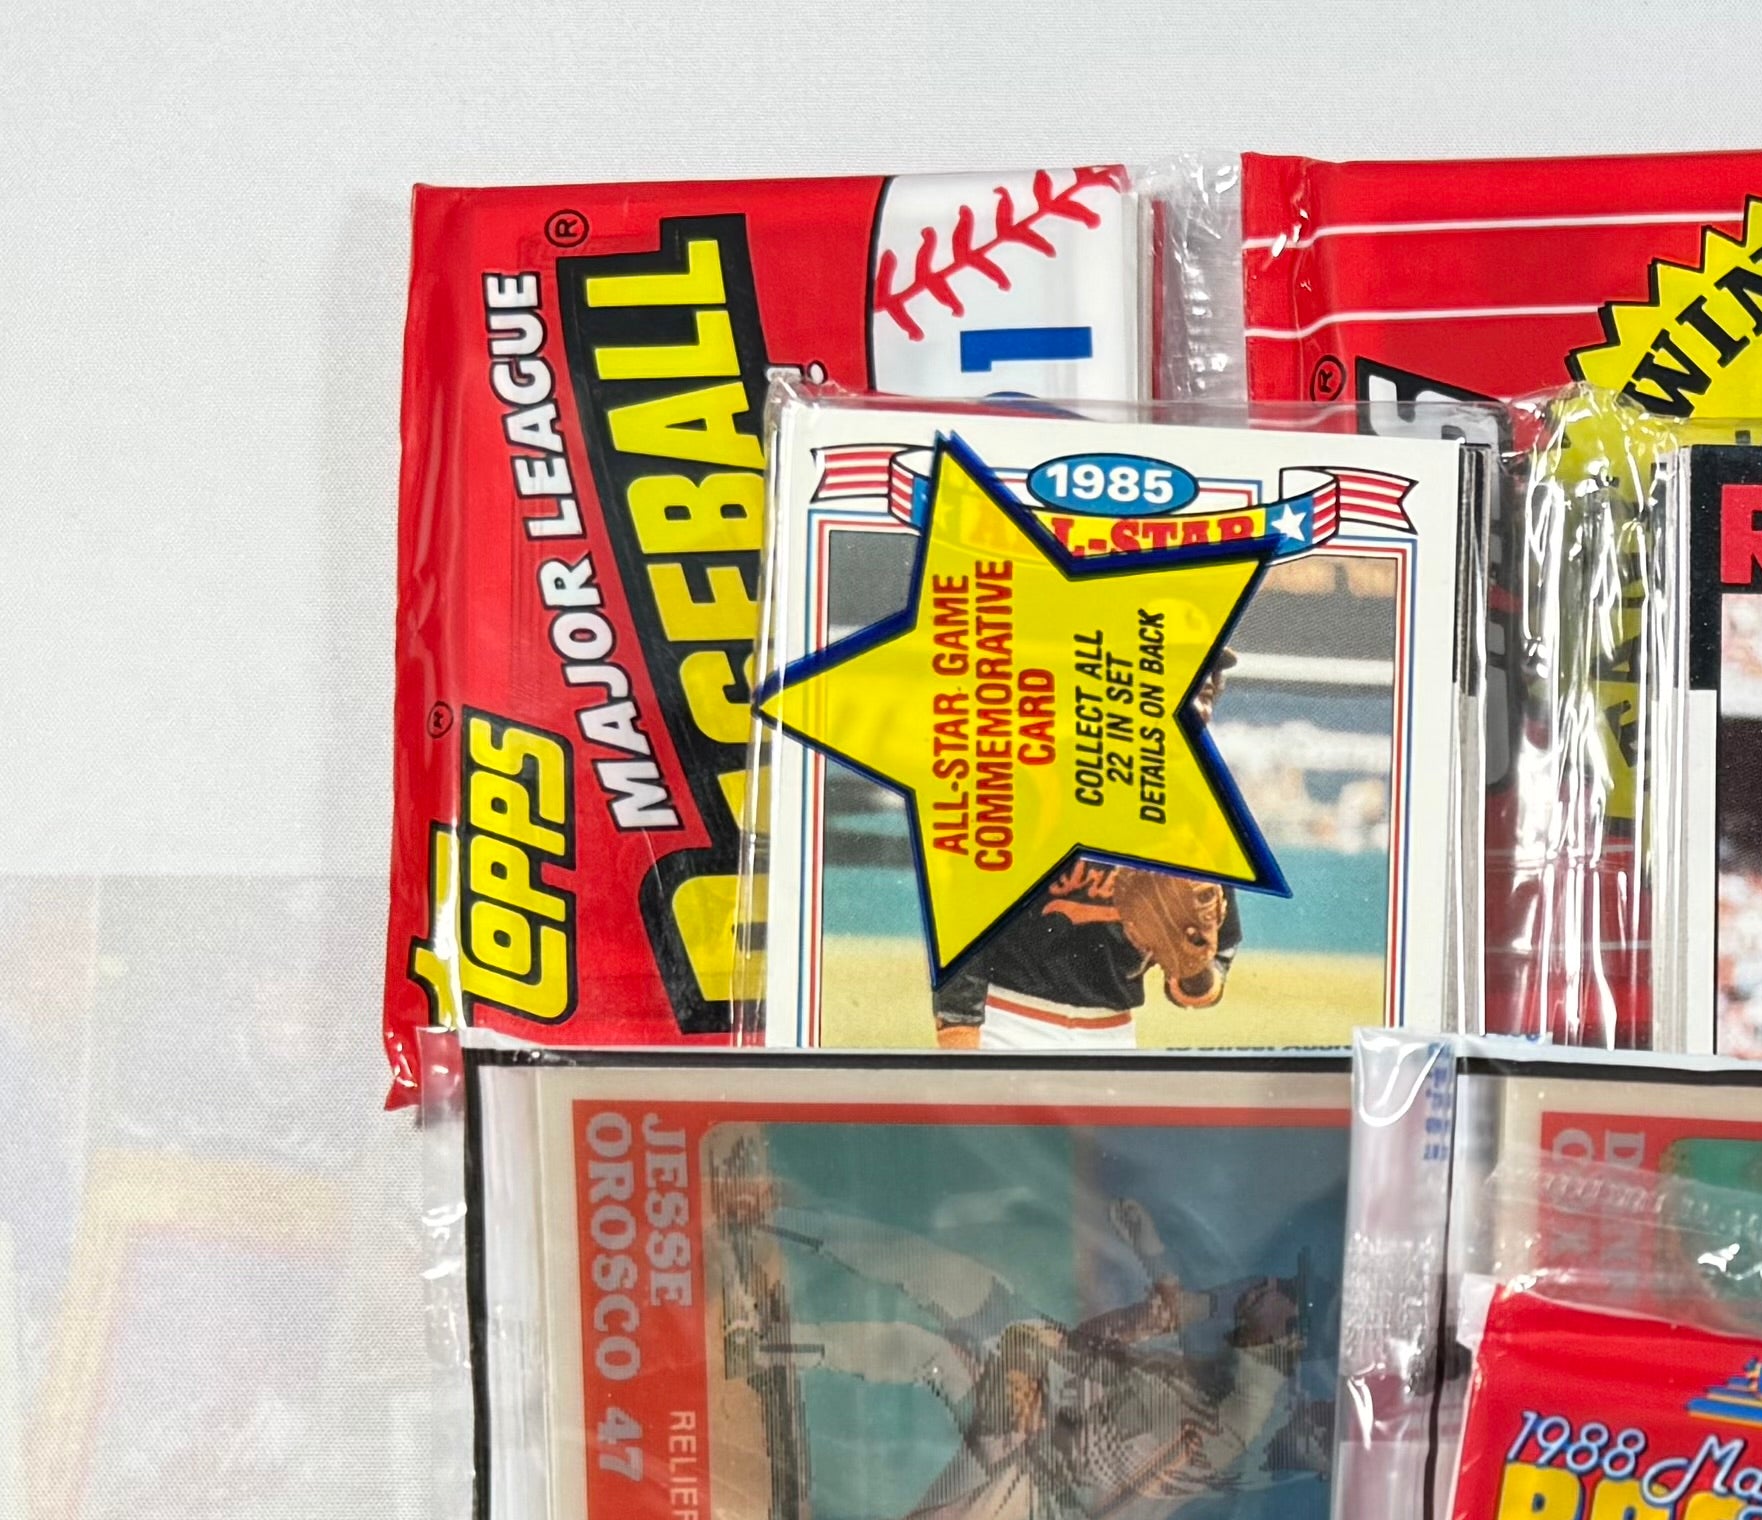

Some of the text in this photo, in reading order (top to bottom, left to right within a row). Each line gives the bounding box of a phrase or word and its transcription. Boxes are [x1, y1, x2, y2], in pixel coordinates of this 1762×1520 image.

[482, 272, 681, 830] MAJOR LEAGUE
[1045, 462, 1174, 503] 1985
[932, 573, 971, 855] ALL-STAR GAME
[974, 559, 1014, 871] COMMEMORATIVE
[1017, 667, 1057, 766] CARD
[1074, 630, 1104, 807] COLLECT ALL
[1106, 651, 1134, 786] 22 IN SET
[1138, 608, 1166, 824] DETAILS ON BACK
[585, 1111, 644, 1482] OROSCO 47
[641, 1112, 693, 1308] JESSE
[1507, 1412, 1646, 1479] 1988
